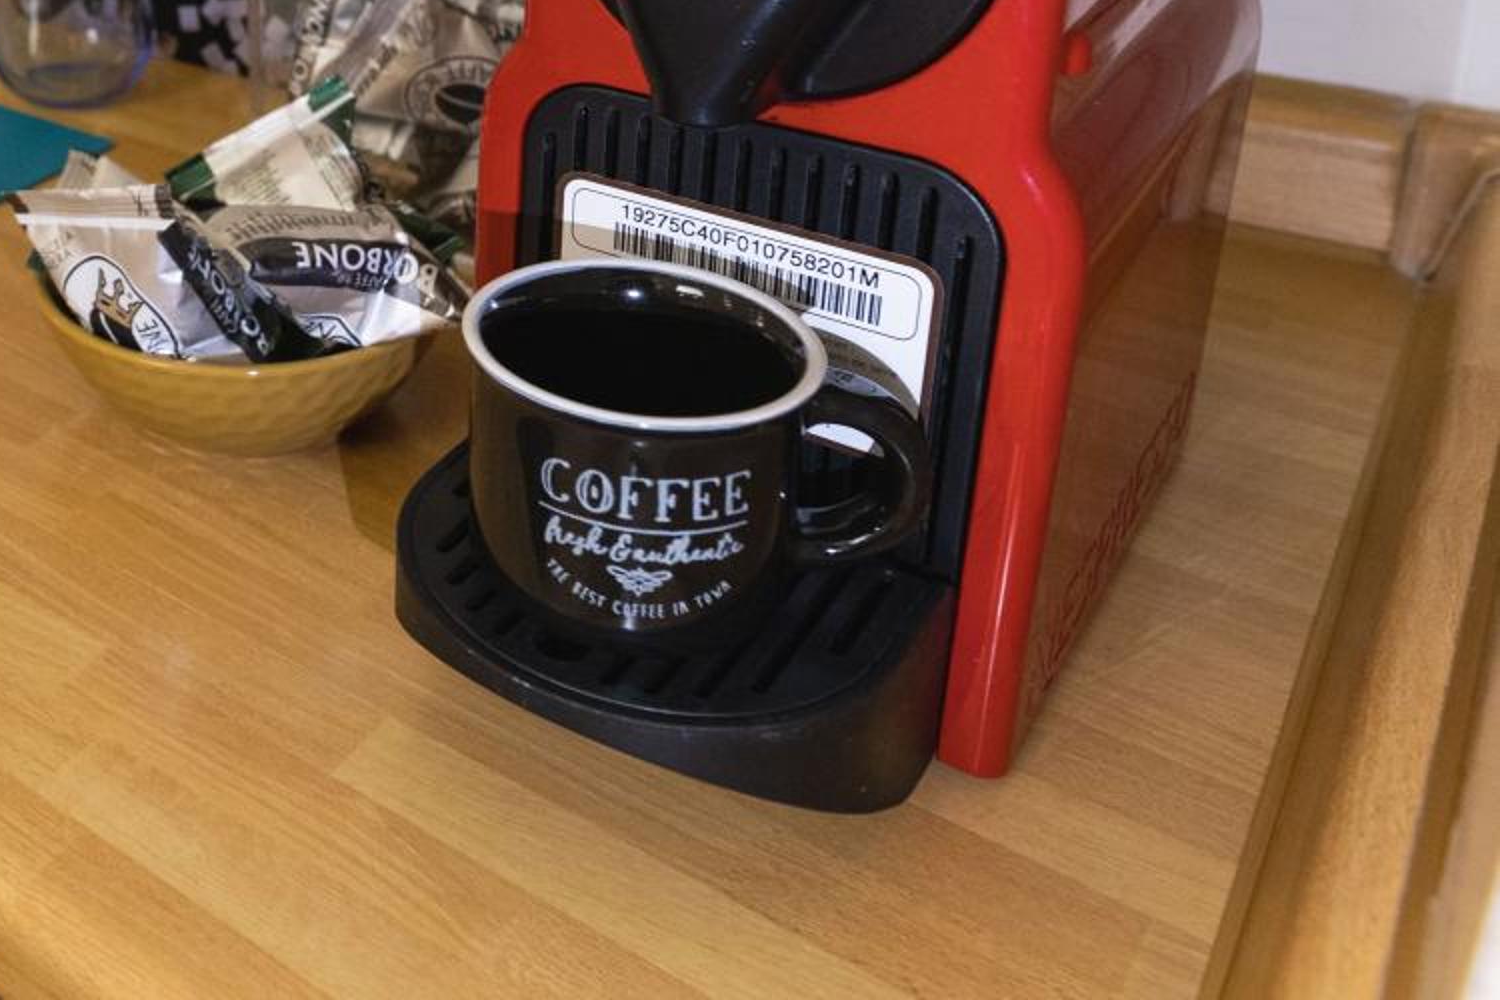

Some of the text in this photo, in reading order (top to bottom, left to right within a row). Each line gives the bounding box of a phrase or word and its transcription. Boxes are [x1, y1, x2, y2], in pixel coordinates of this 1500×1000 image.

[621, 204, 879, 290] 19275C40F010758201M
[540, 457, 751, 523] COFFEE
[547, 558, 732, 619] THE BEST COFFEE IN TOWN
